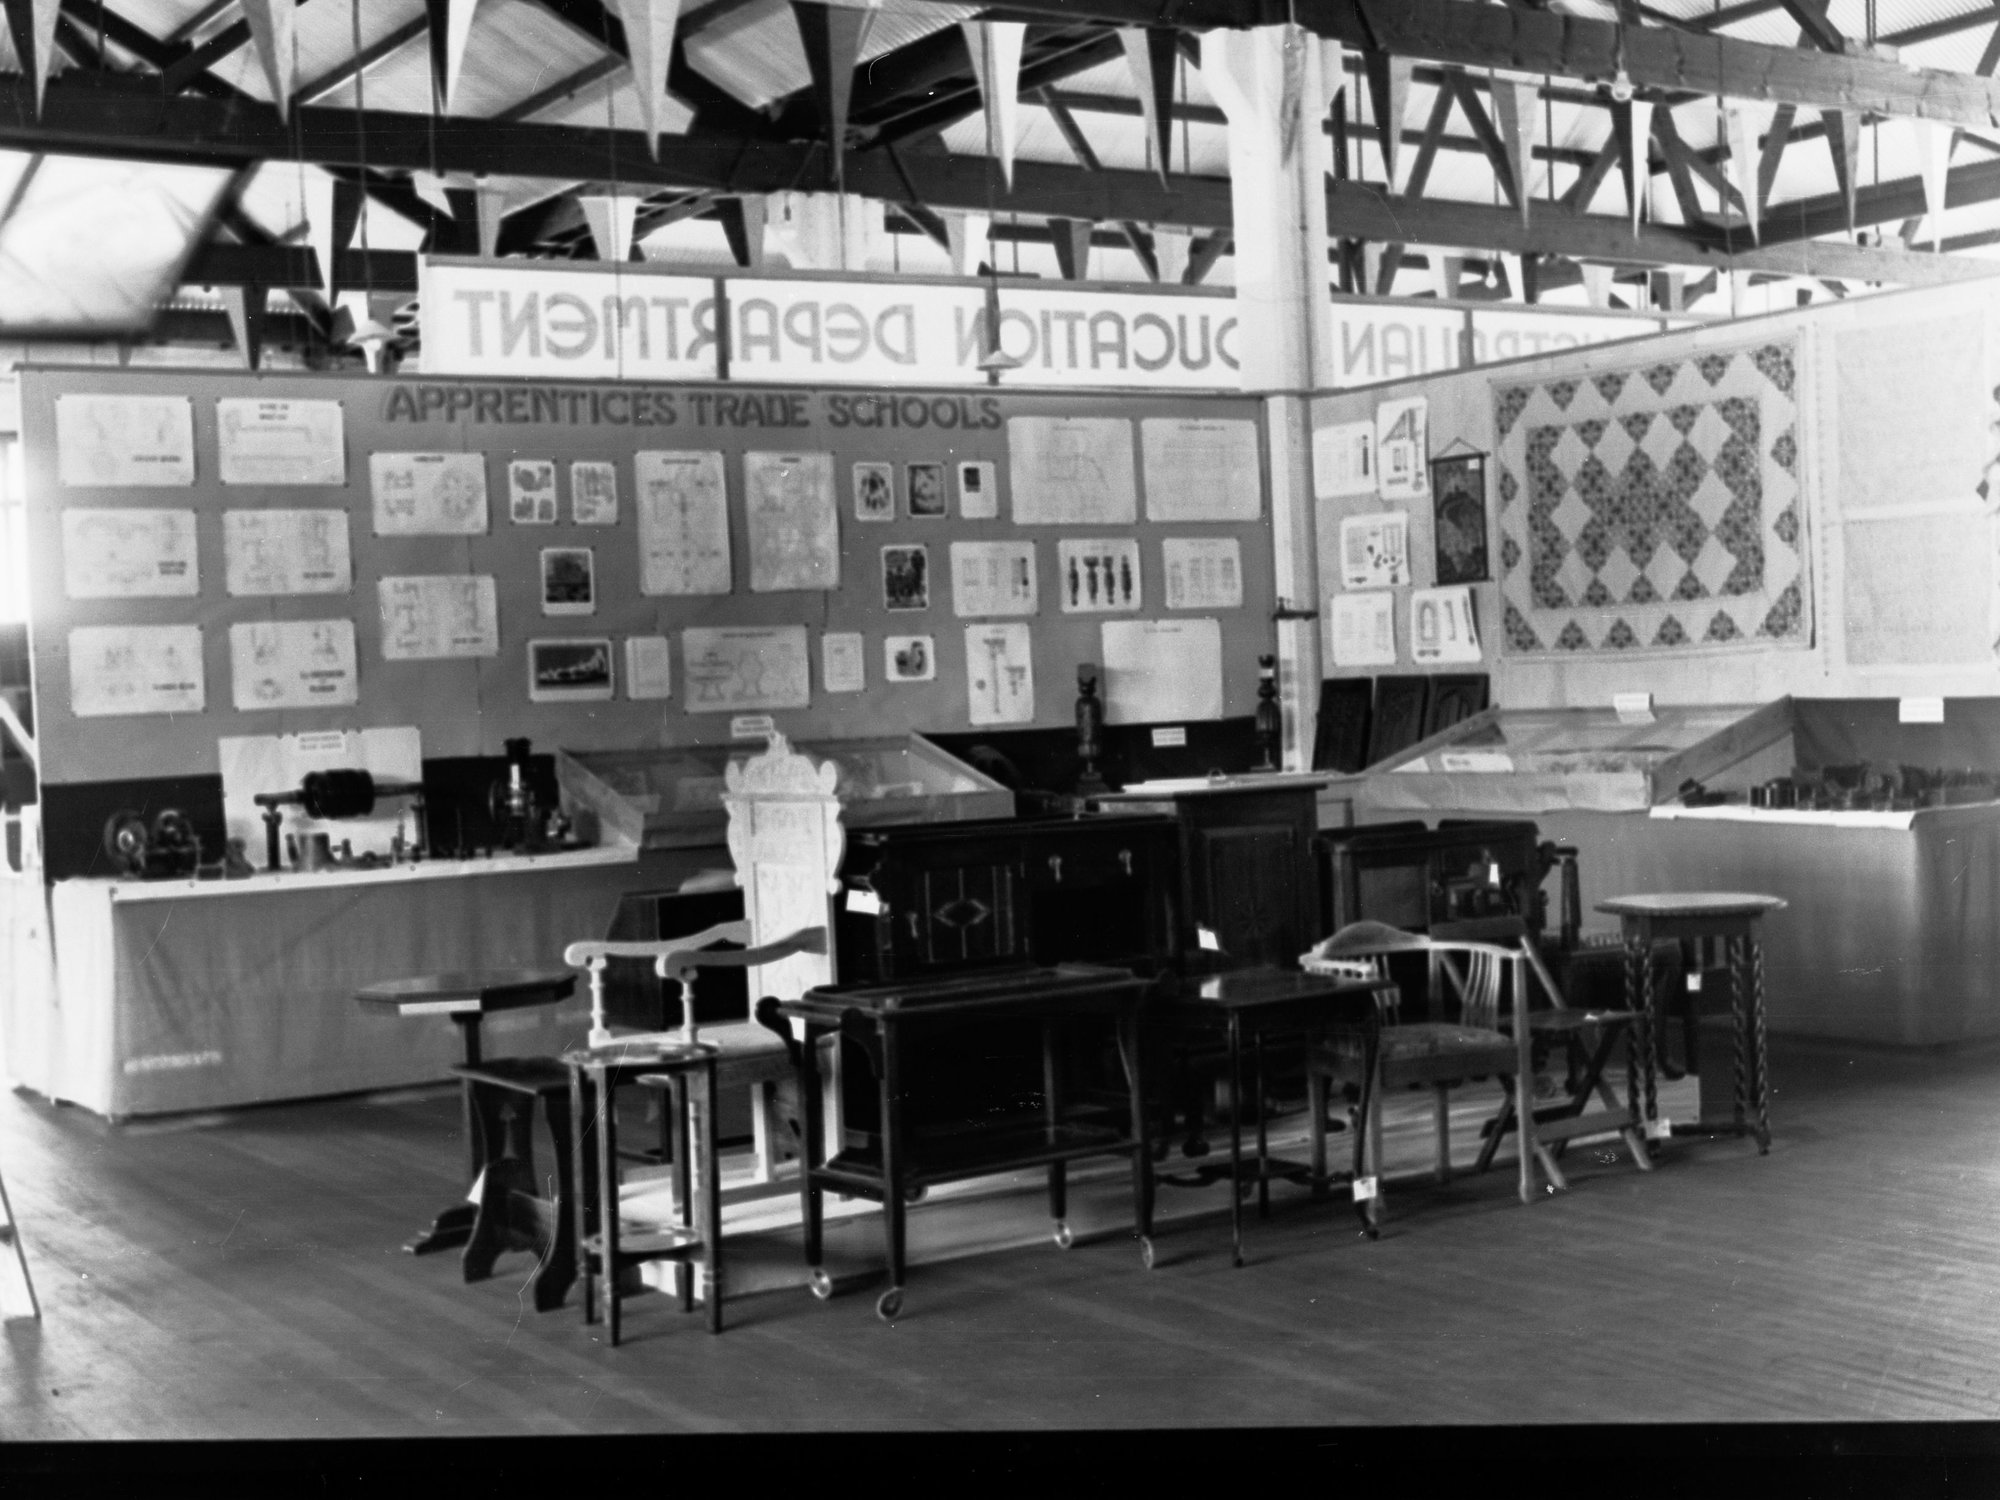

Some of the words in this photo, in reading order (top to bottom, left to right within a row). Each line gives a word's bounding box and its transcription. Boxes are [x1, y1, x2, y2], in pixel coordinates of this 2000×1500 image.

[385, 384, 678, 427] APPRENTICES
[689, 393, 810, 428] TRADE
[828, 394, 1001, 429] SCHOOLS
